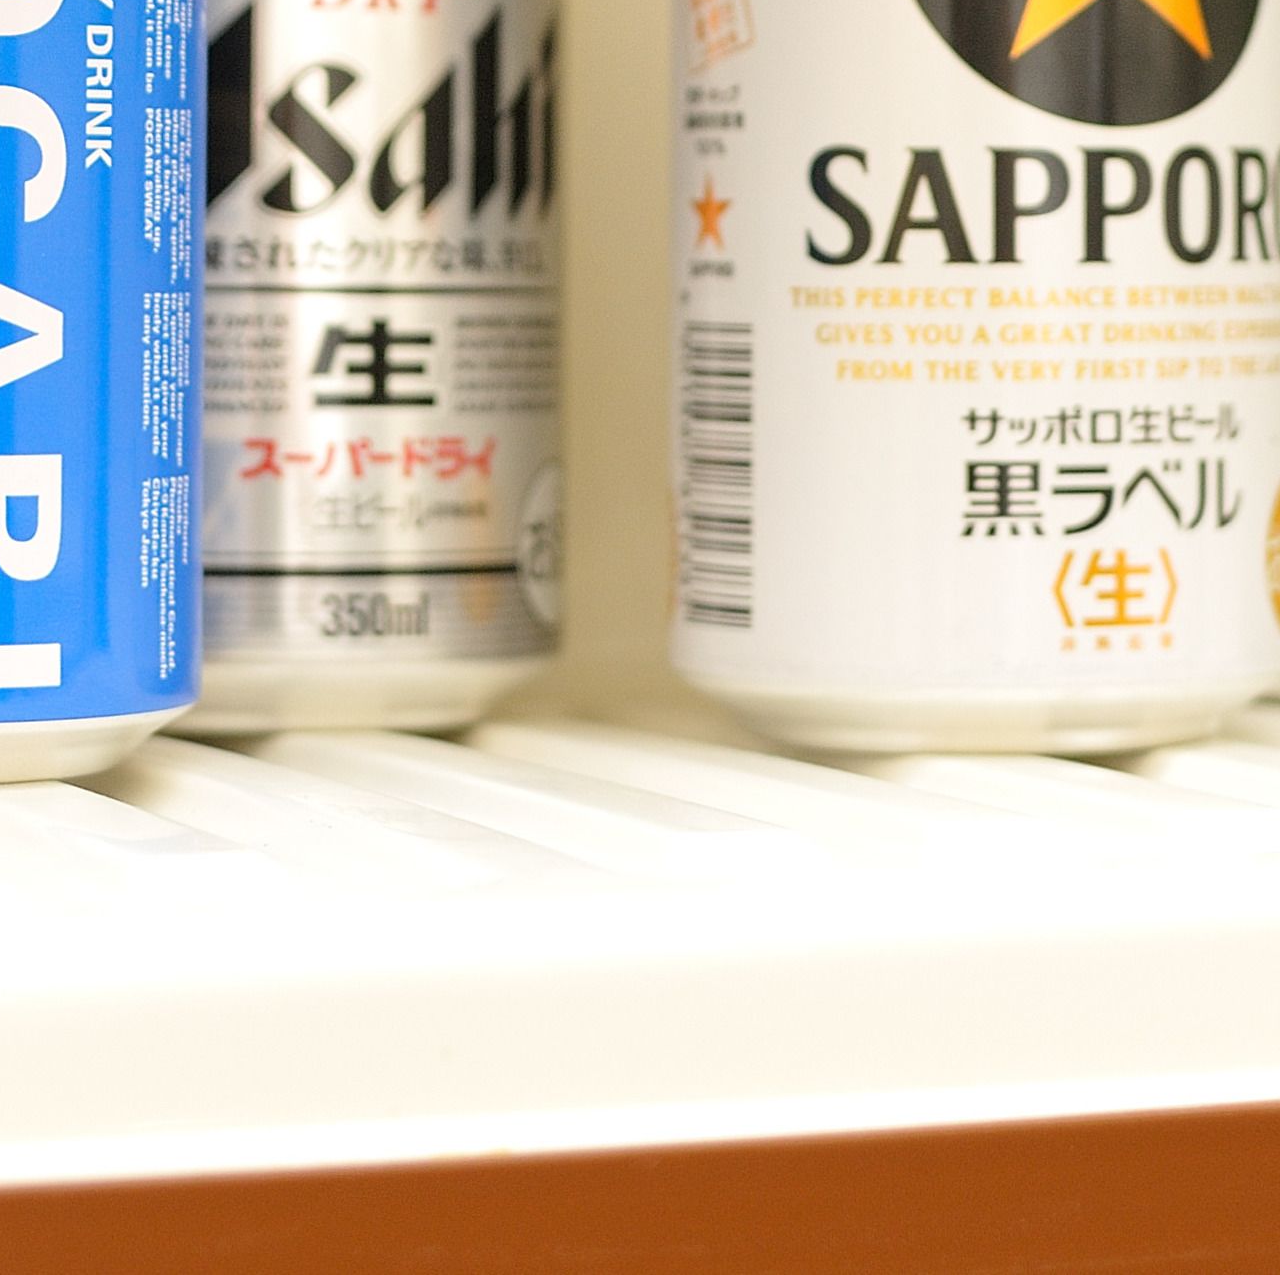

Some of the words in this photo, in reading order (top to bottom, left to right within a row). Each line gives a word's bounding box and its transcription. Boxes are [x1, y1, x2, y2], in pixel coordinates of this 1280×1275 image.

[84, 26, 113, 168] DRINK
[790, 284, 845, 309] THIS
[854, 285, 977, 310] PERFECT
[987, 285, 1117, 310] BALANCE
[1126, 283, 1229, 308] BETWEEN
[816, 322, 894, 346] GIVES
[906, 323, 965, 347] YOU
[972, 322, 992, 346] A
[1000, 323, 1093, 346] GREAT
[1103, 321, 1217, 344] DRINKING
[313, 315, 436, 406] 生
[836, 359, 914, 382] FROM
[926, 359, 979, 383] THE
[991, 359, 1063, 382] VERY
[1075, 358, 1147, 382] FIRST
[961, 406, 1240, 446] サッポロ生ビール
[239, 436, 498, 480] スーパードライ
[960, 457, 1243, 537] 黒ラベル
[321, 592, 432, 638] 350ml
